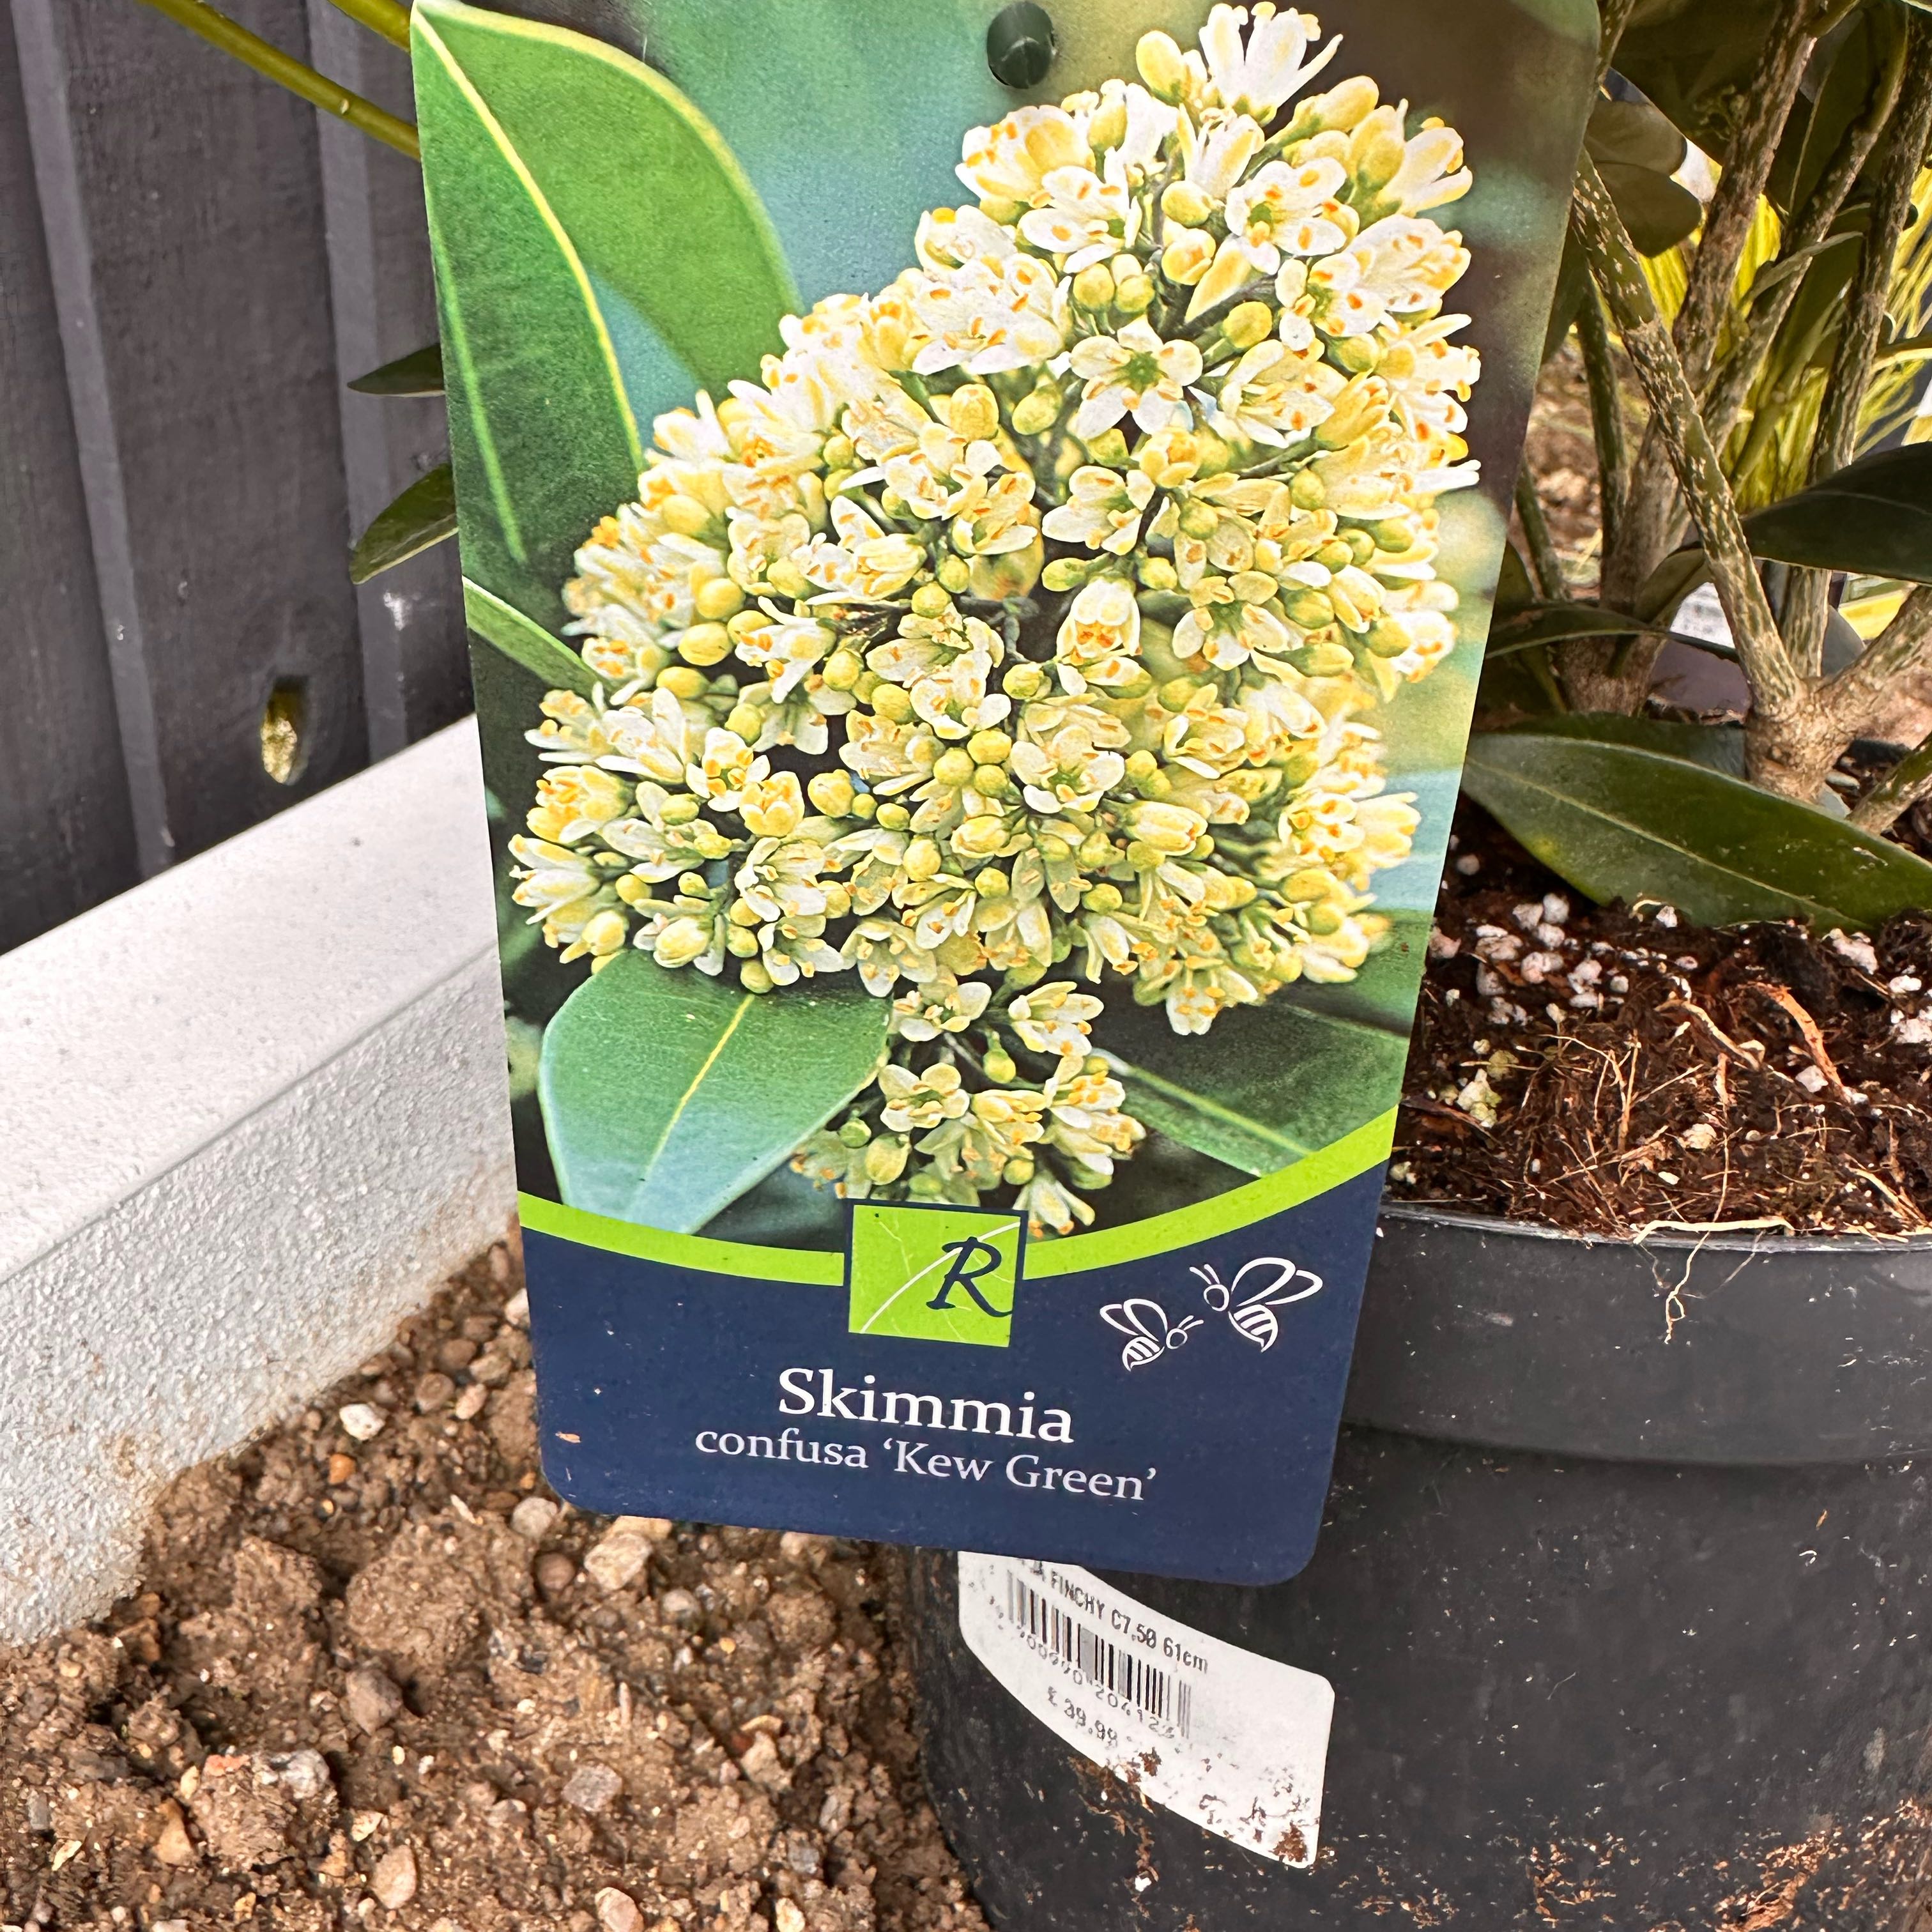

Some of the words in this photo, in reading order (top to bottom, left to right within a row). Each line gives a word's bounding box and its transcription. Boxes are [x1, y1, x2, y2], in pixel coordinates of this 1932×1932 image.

[926, 1236, 1012, 1318] R
[778, 1367, 1075, 1444] Skimmia
[695, 1427, 869, 1469] confusa
[1051, 1570, 1106, 1620] FINCHY
[1163, 1636, 1209, 1675] 61cm
